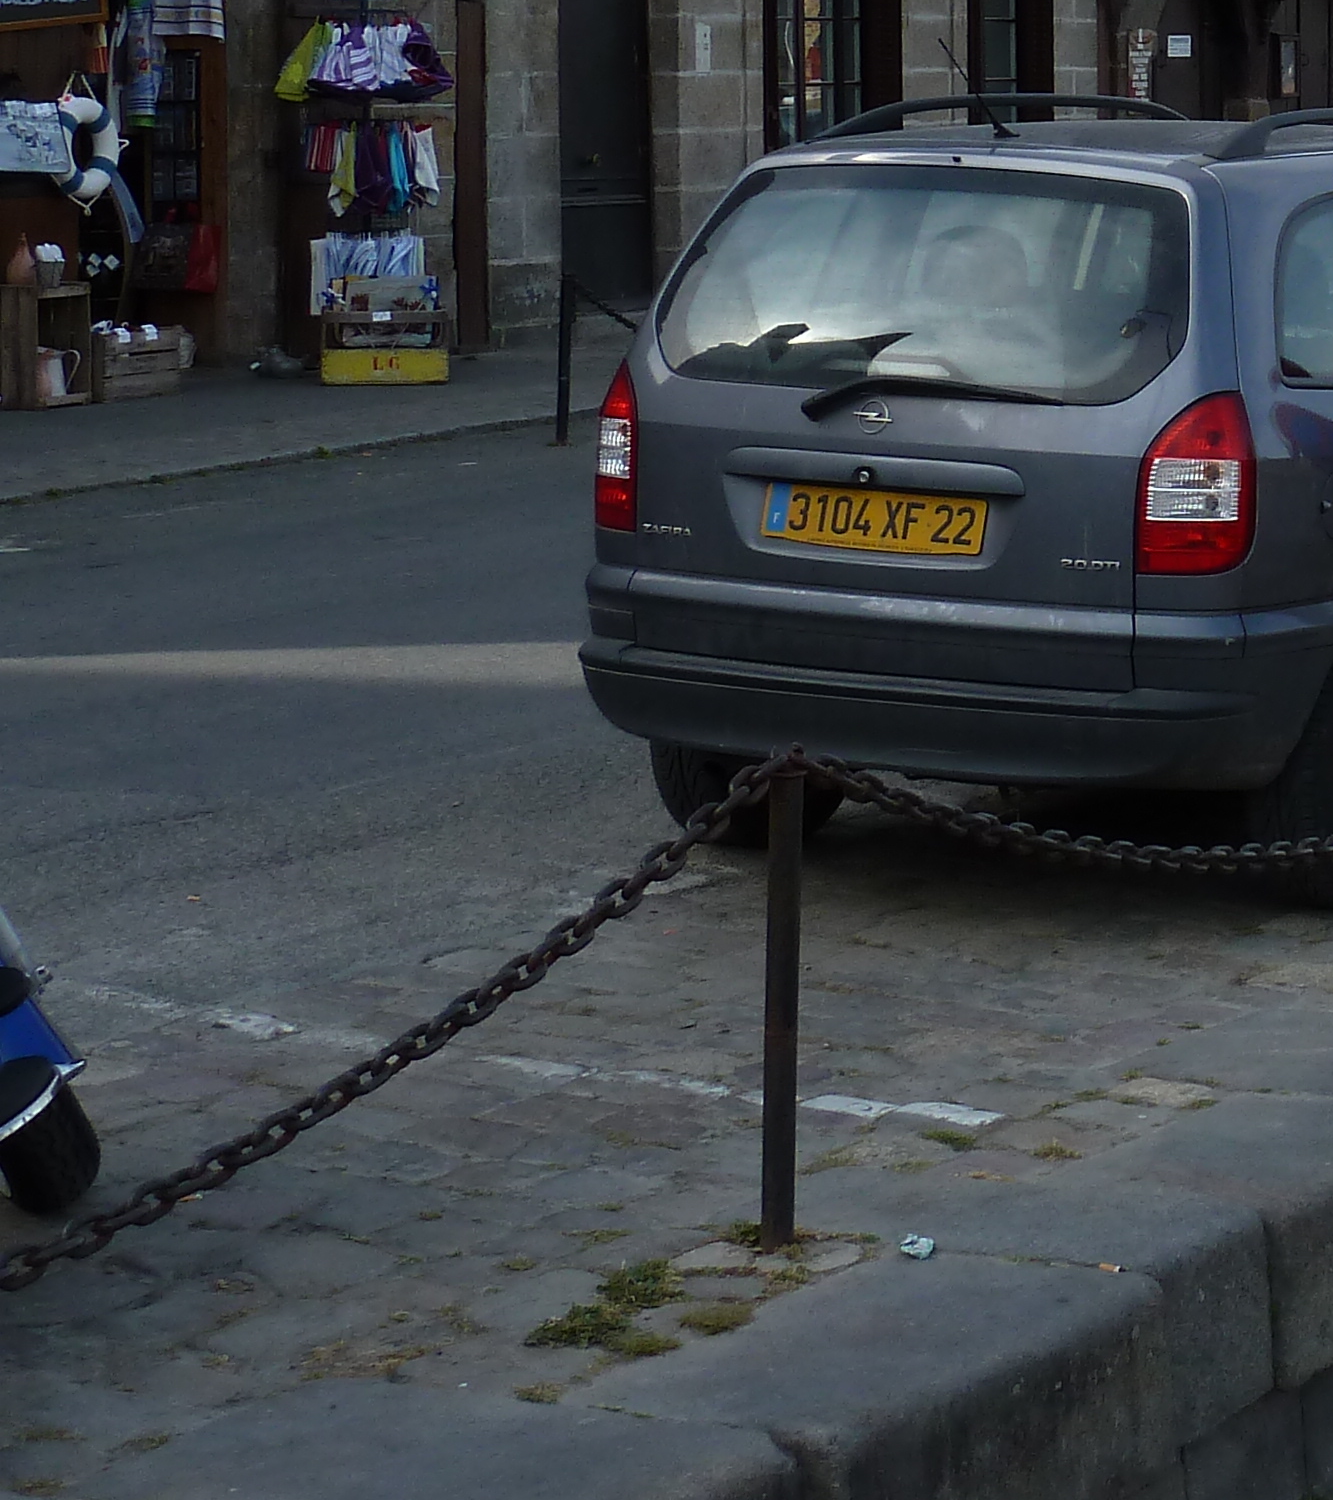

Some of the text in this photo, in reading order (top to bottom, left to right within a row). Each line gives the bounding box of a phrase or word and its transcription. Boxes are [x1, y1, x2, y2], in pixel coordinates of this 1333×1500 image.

[773, 492, 977, 547] F 3104 XF 22
